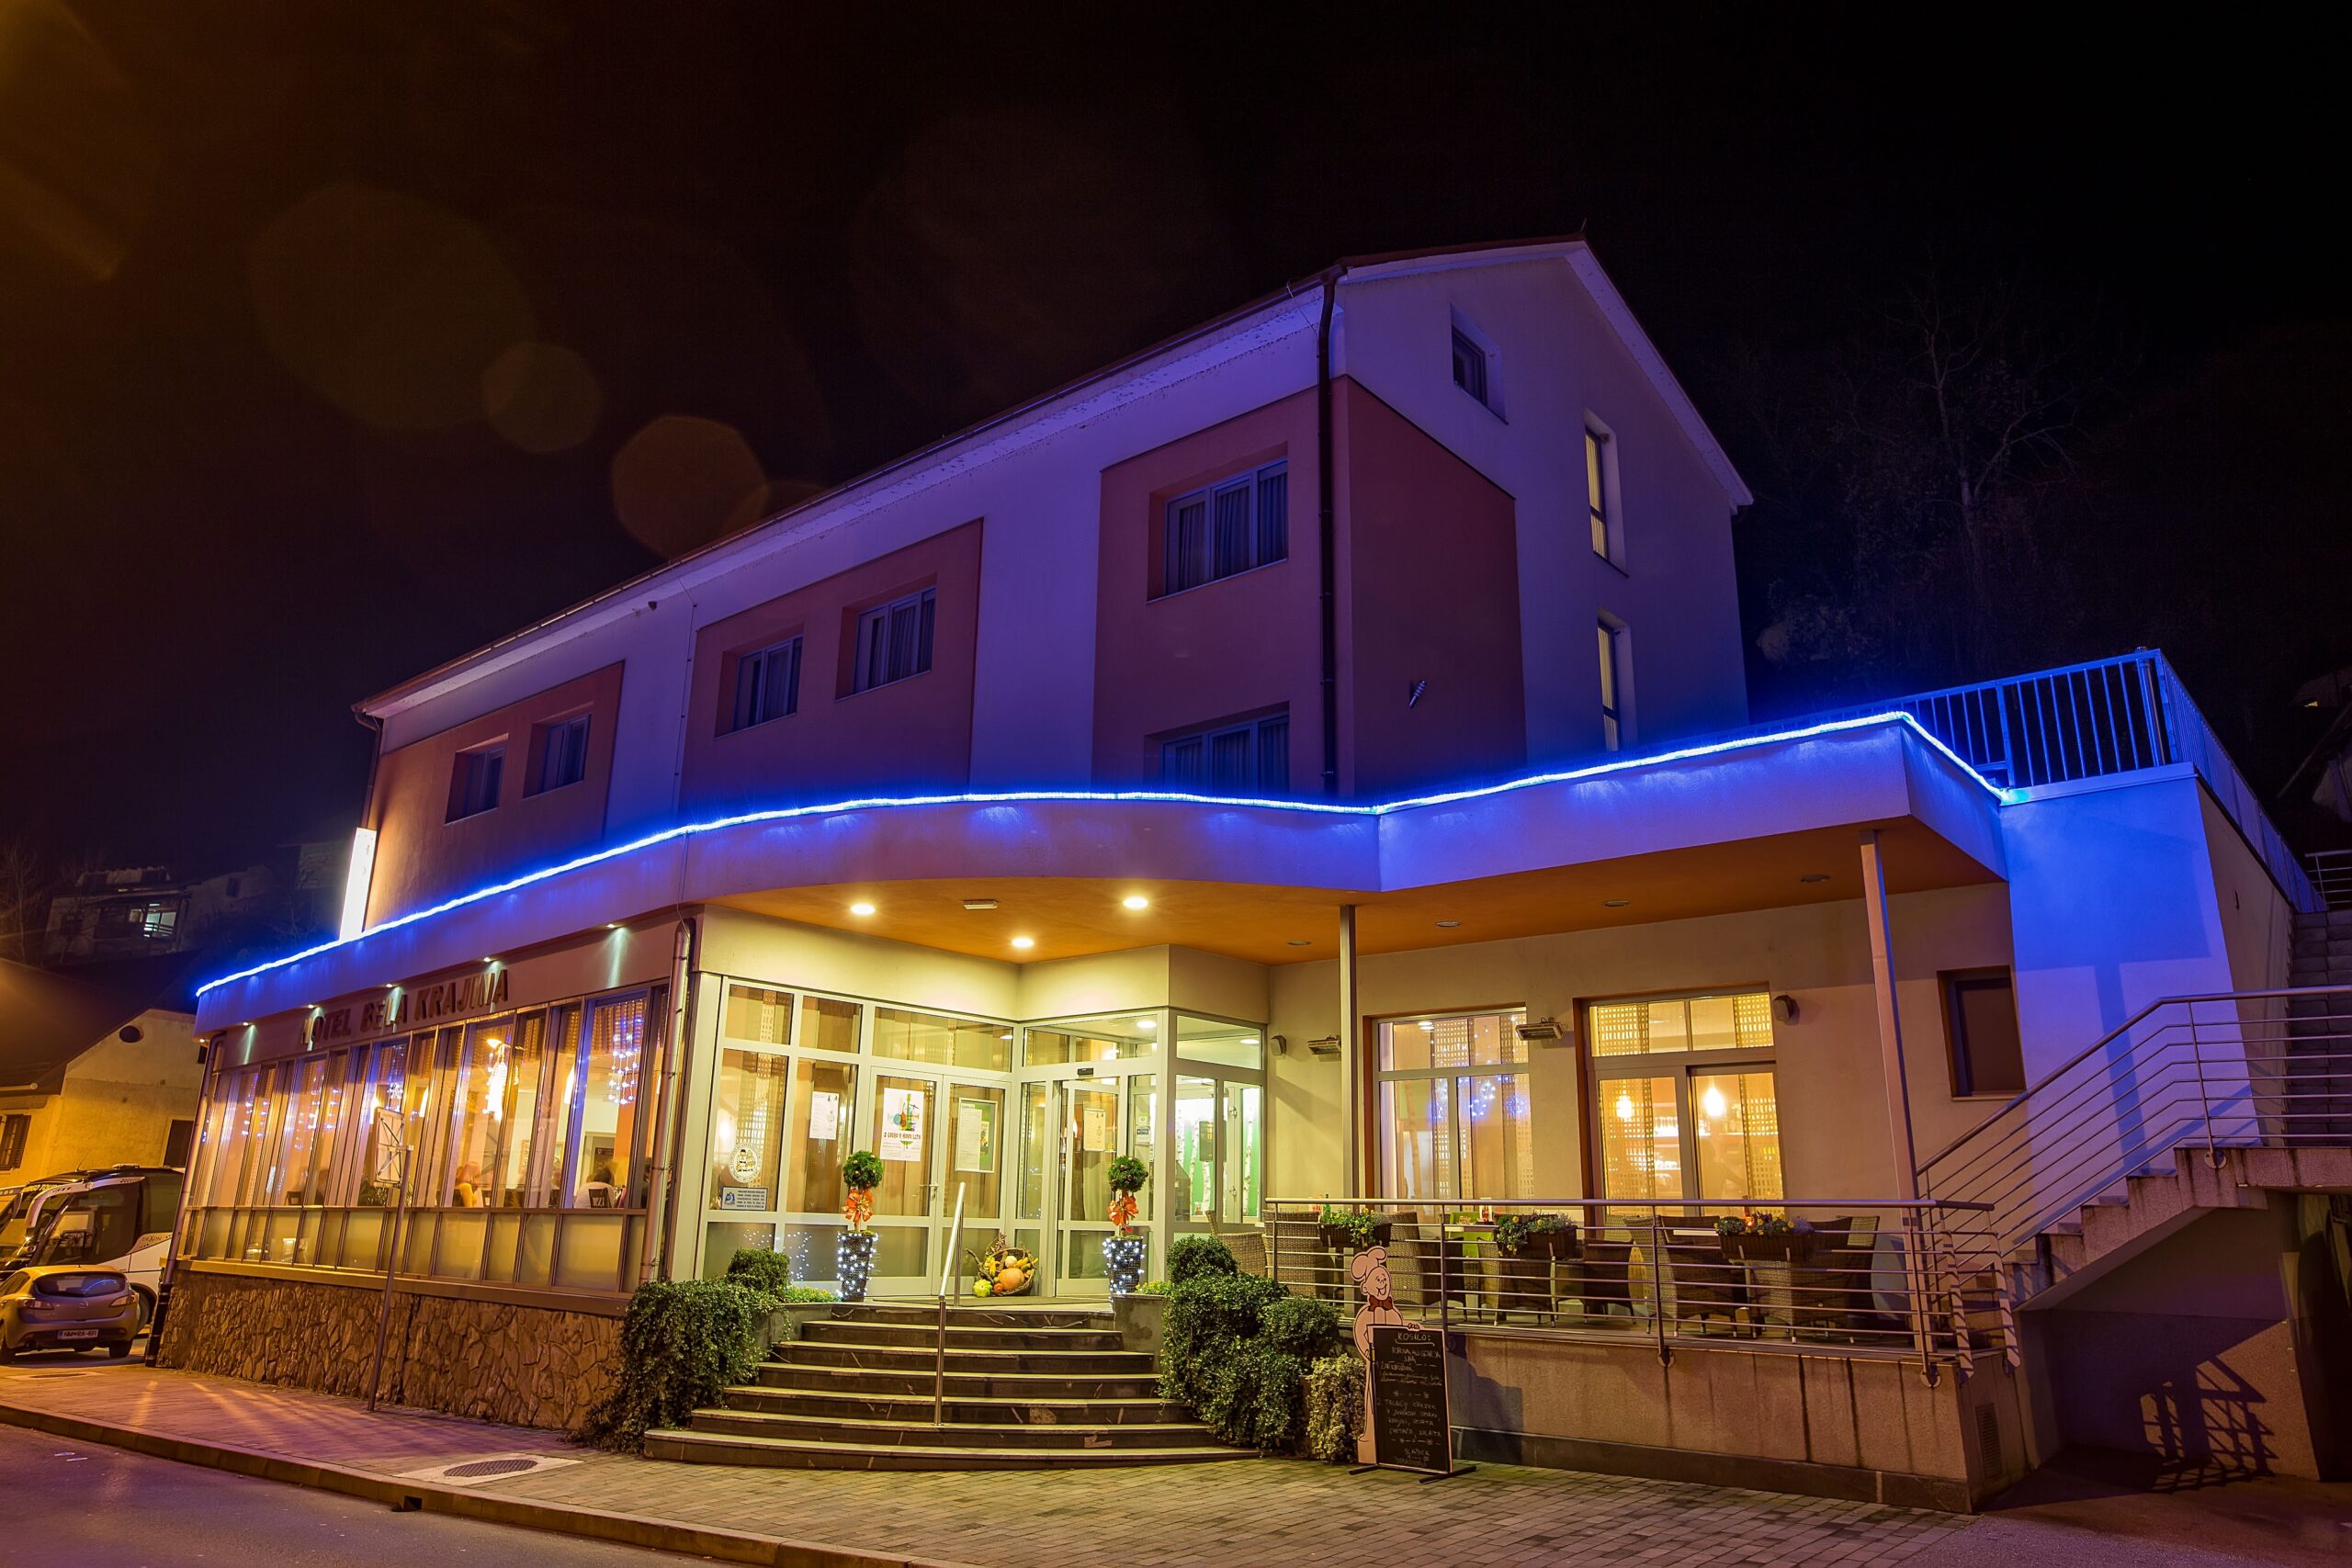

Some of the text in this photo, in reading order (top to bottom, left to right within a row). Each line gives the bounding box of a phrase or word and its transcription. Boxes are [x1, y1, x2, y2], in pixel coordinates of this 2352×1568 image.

[300, 969, 509, 1045] HOTEL BELA KRAJINA
[1397, 1331, 1430, 1341] KOSILO:
